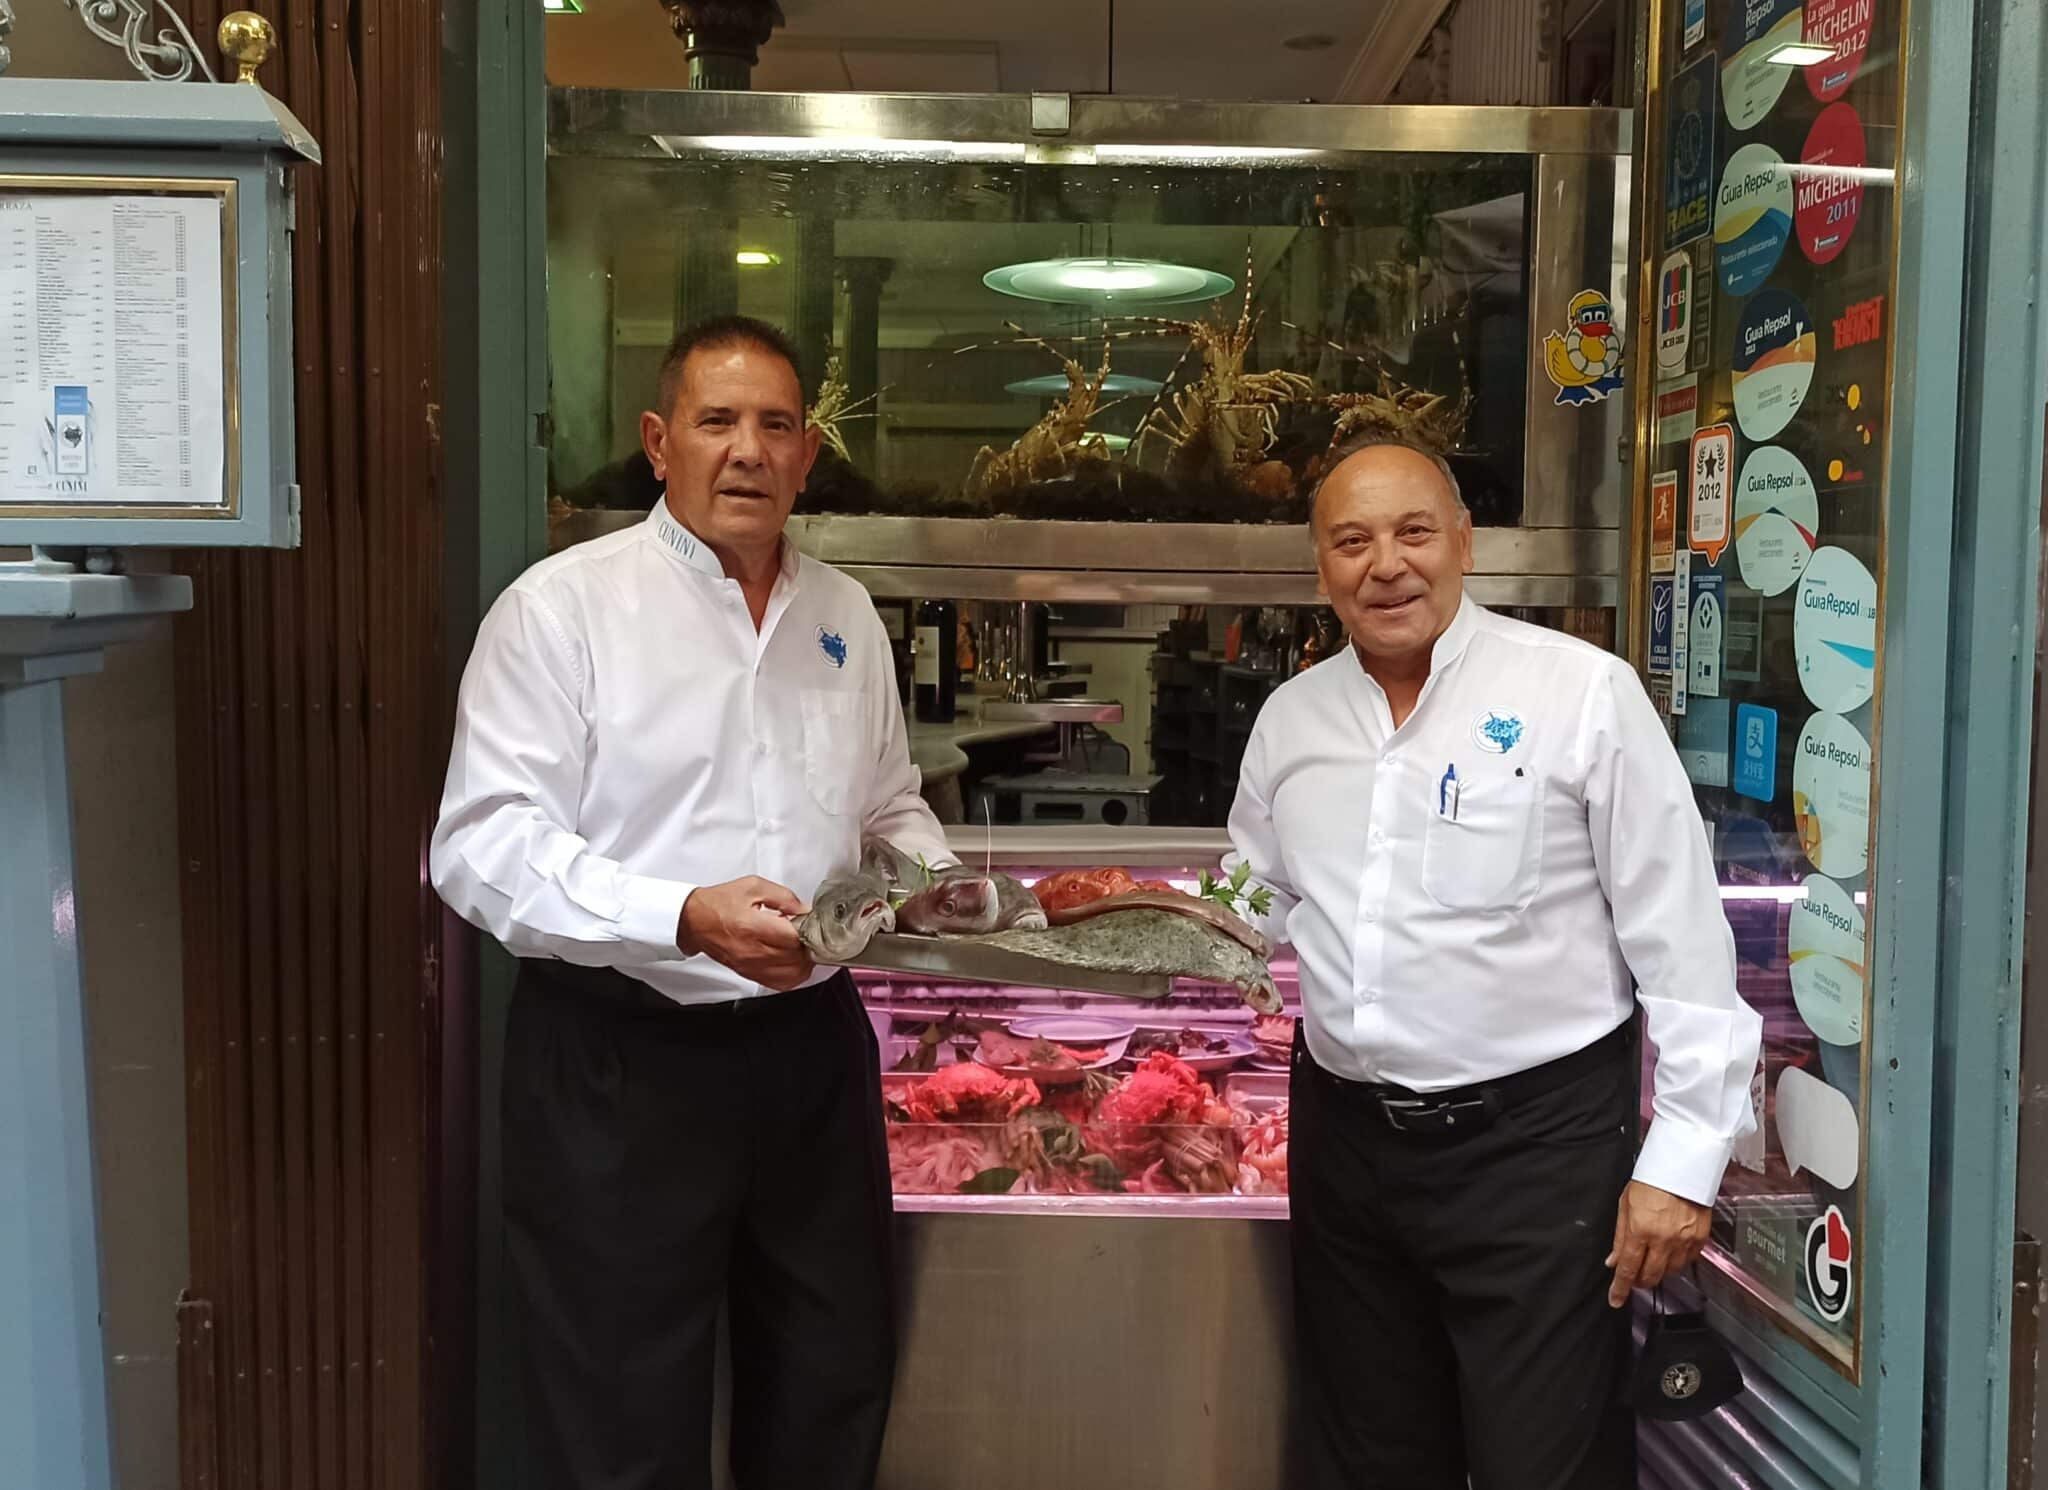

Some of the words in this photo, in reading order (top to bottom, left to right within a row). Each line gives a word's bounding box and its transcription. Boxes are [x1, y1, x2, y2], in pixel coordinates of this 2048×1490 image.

[1806, 0, 1869, 46] MICHELIN
[1834, 30, 1867, 62] 2012
[1744, 160, 1777, 196] Repsol
[1798, 167, 1862, 212] MICHELIN
[1666, 195, 1707, 232] RACE
[1826, 196, 1857, 225] 2011
[1663, 290, 1686, 309] JCB
[1764, 307, 1792, 337] Repsol
[1698, 482, 1722, 502] 2012
[1766, 471, 1794, 493] Repsol
[657, 520, 697, 560] CUNINI
[1826, 592, 1860, 619] Repsol
[1827, 742, 1861, 769] Repsol
[1822, 903, 1853, 935] Repsol
[1746, 1226, 1787, 1265] gourmet
